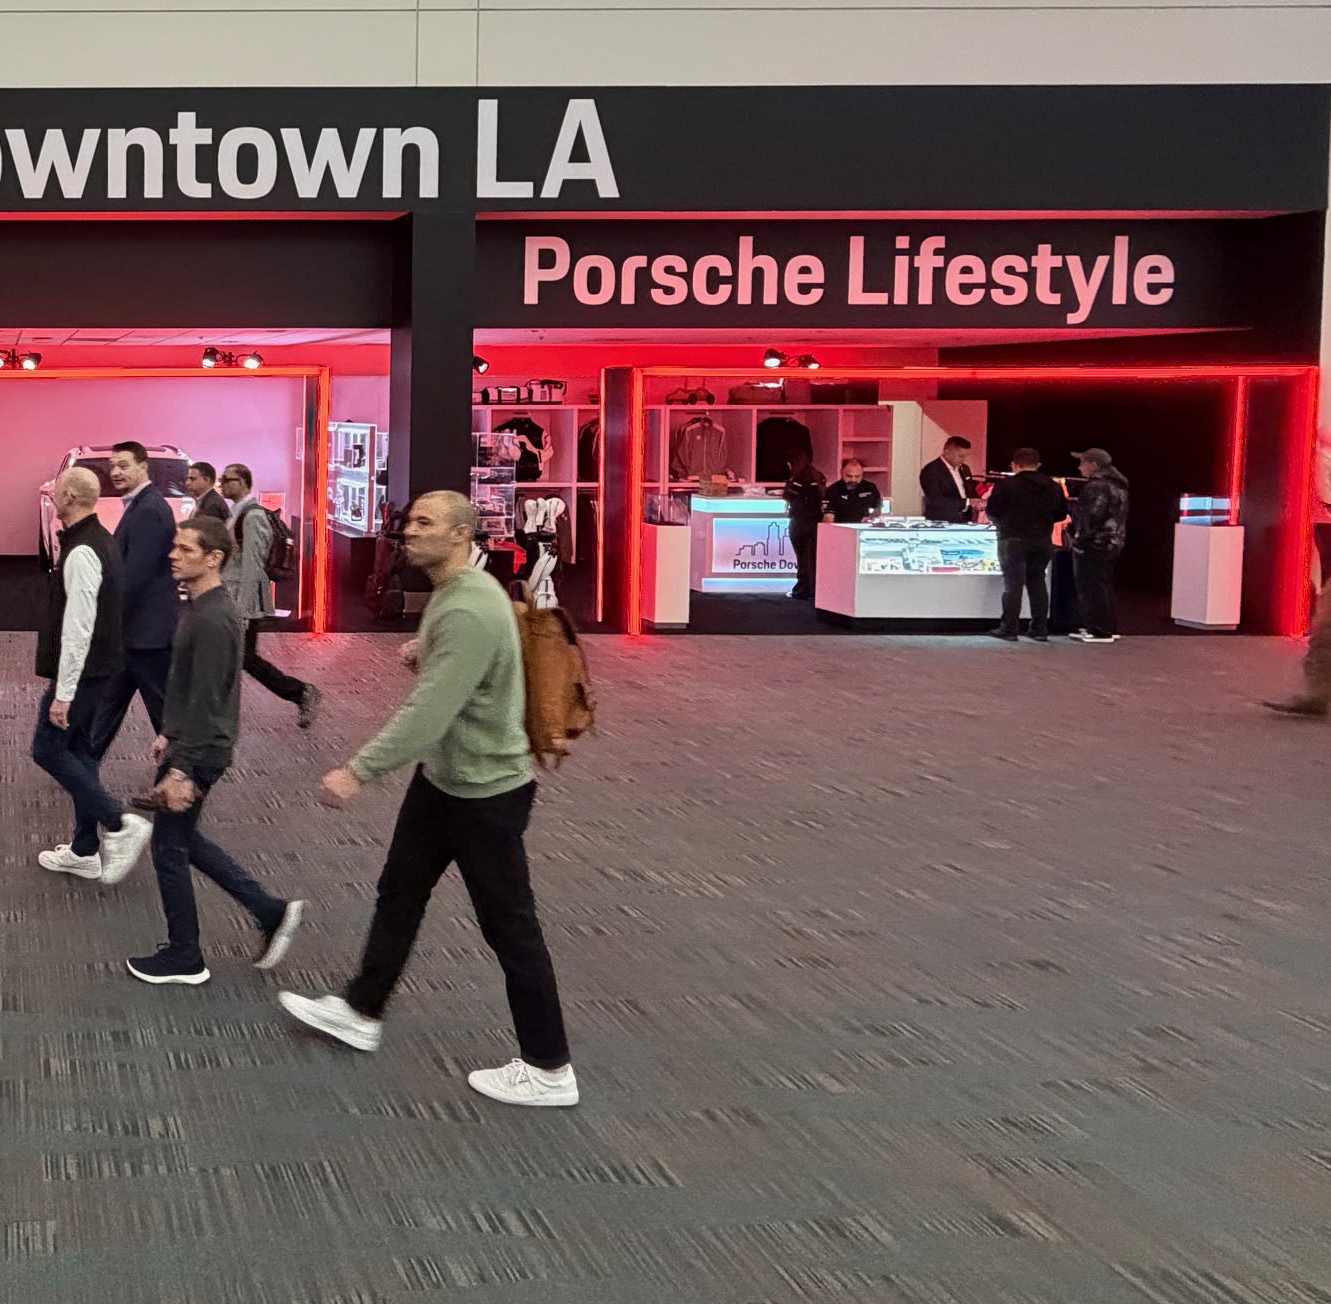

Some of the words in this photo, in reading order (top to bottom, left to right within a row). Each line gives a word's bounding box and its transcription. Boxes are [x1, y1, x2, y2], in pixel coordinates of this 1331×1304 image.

[476, 98, 620, 199] LA
[523, 235, 825, 306] Porsche
[847, 235, 1175, 325] Lifestyle
[733, 559, 776, 570] Porsche
